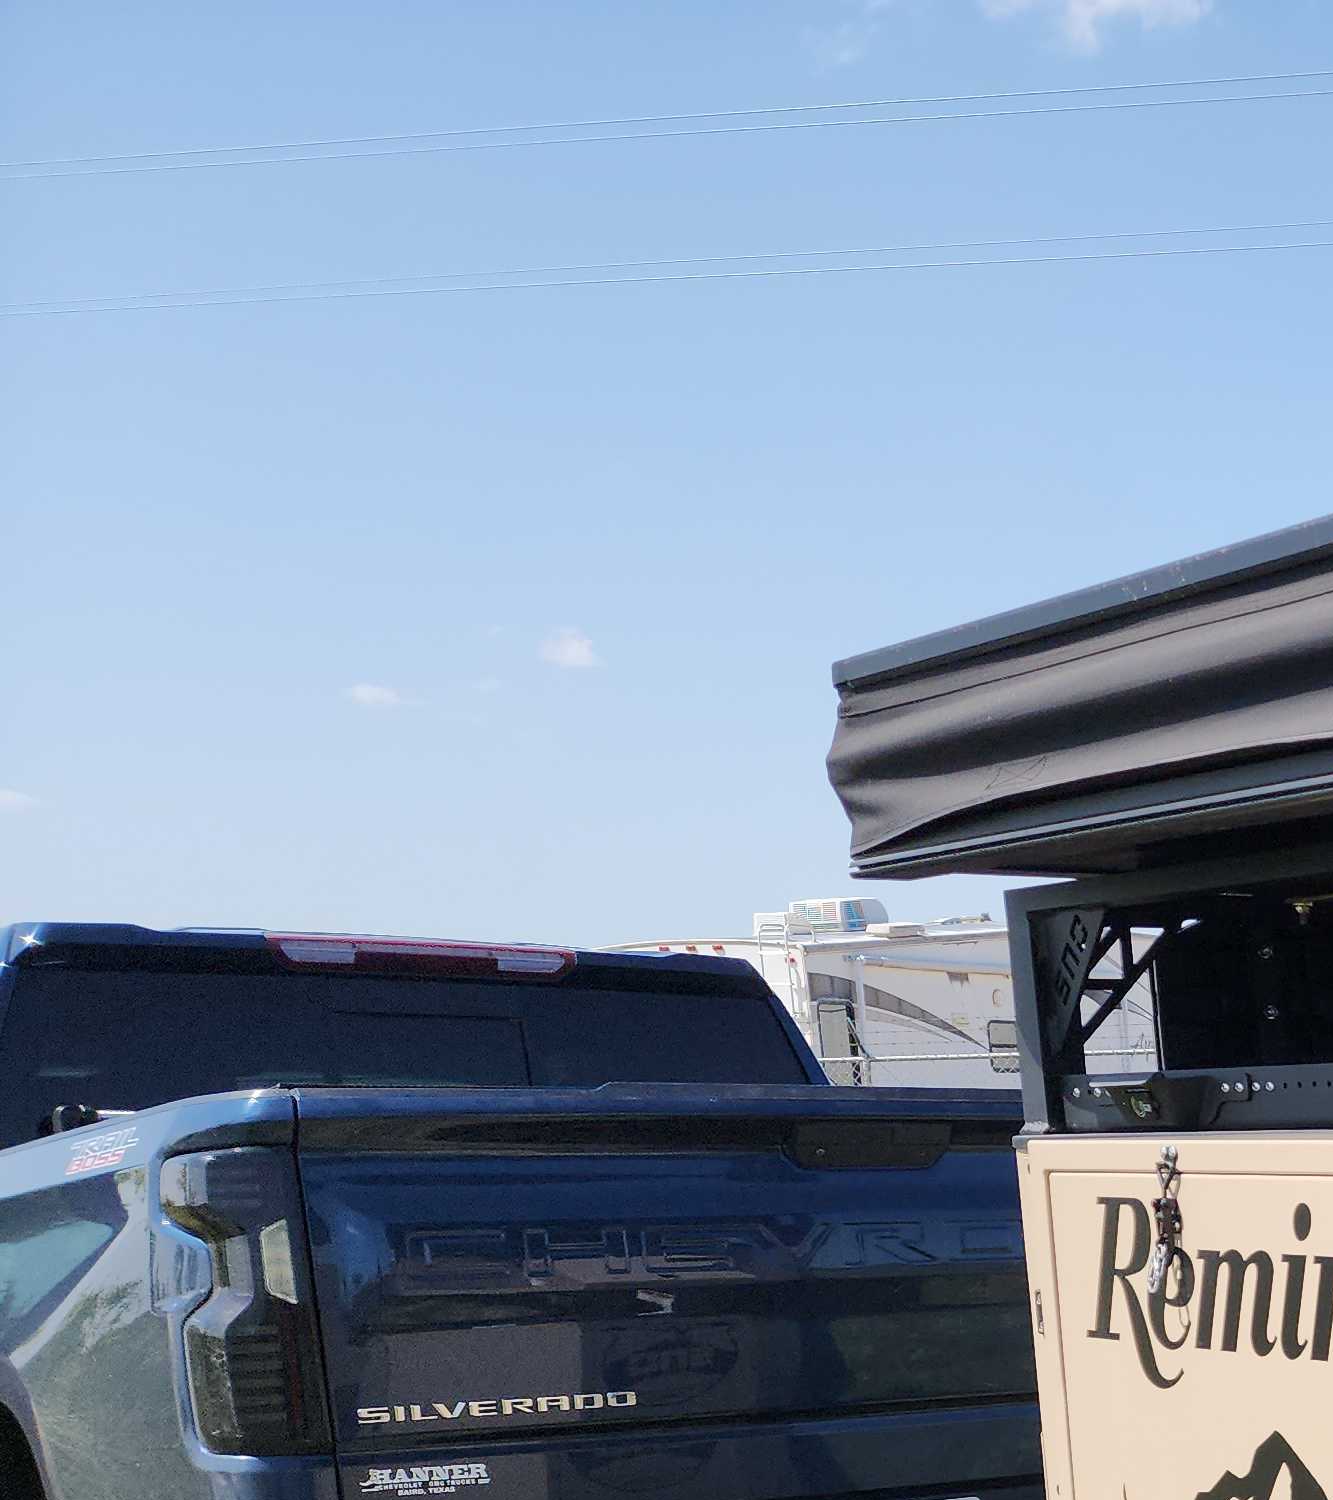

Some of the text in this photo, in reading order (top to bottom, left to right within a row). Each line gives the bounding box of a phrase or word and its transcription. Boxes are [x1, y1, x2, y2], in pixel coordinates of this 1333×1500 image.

[70, 1127, 139, 1159] TRAIL
[64, 1150, 126, 1175] BOSS
[357, 1390, 638, 1426] SILVERADO
